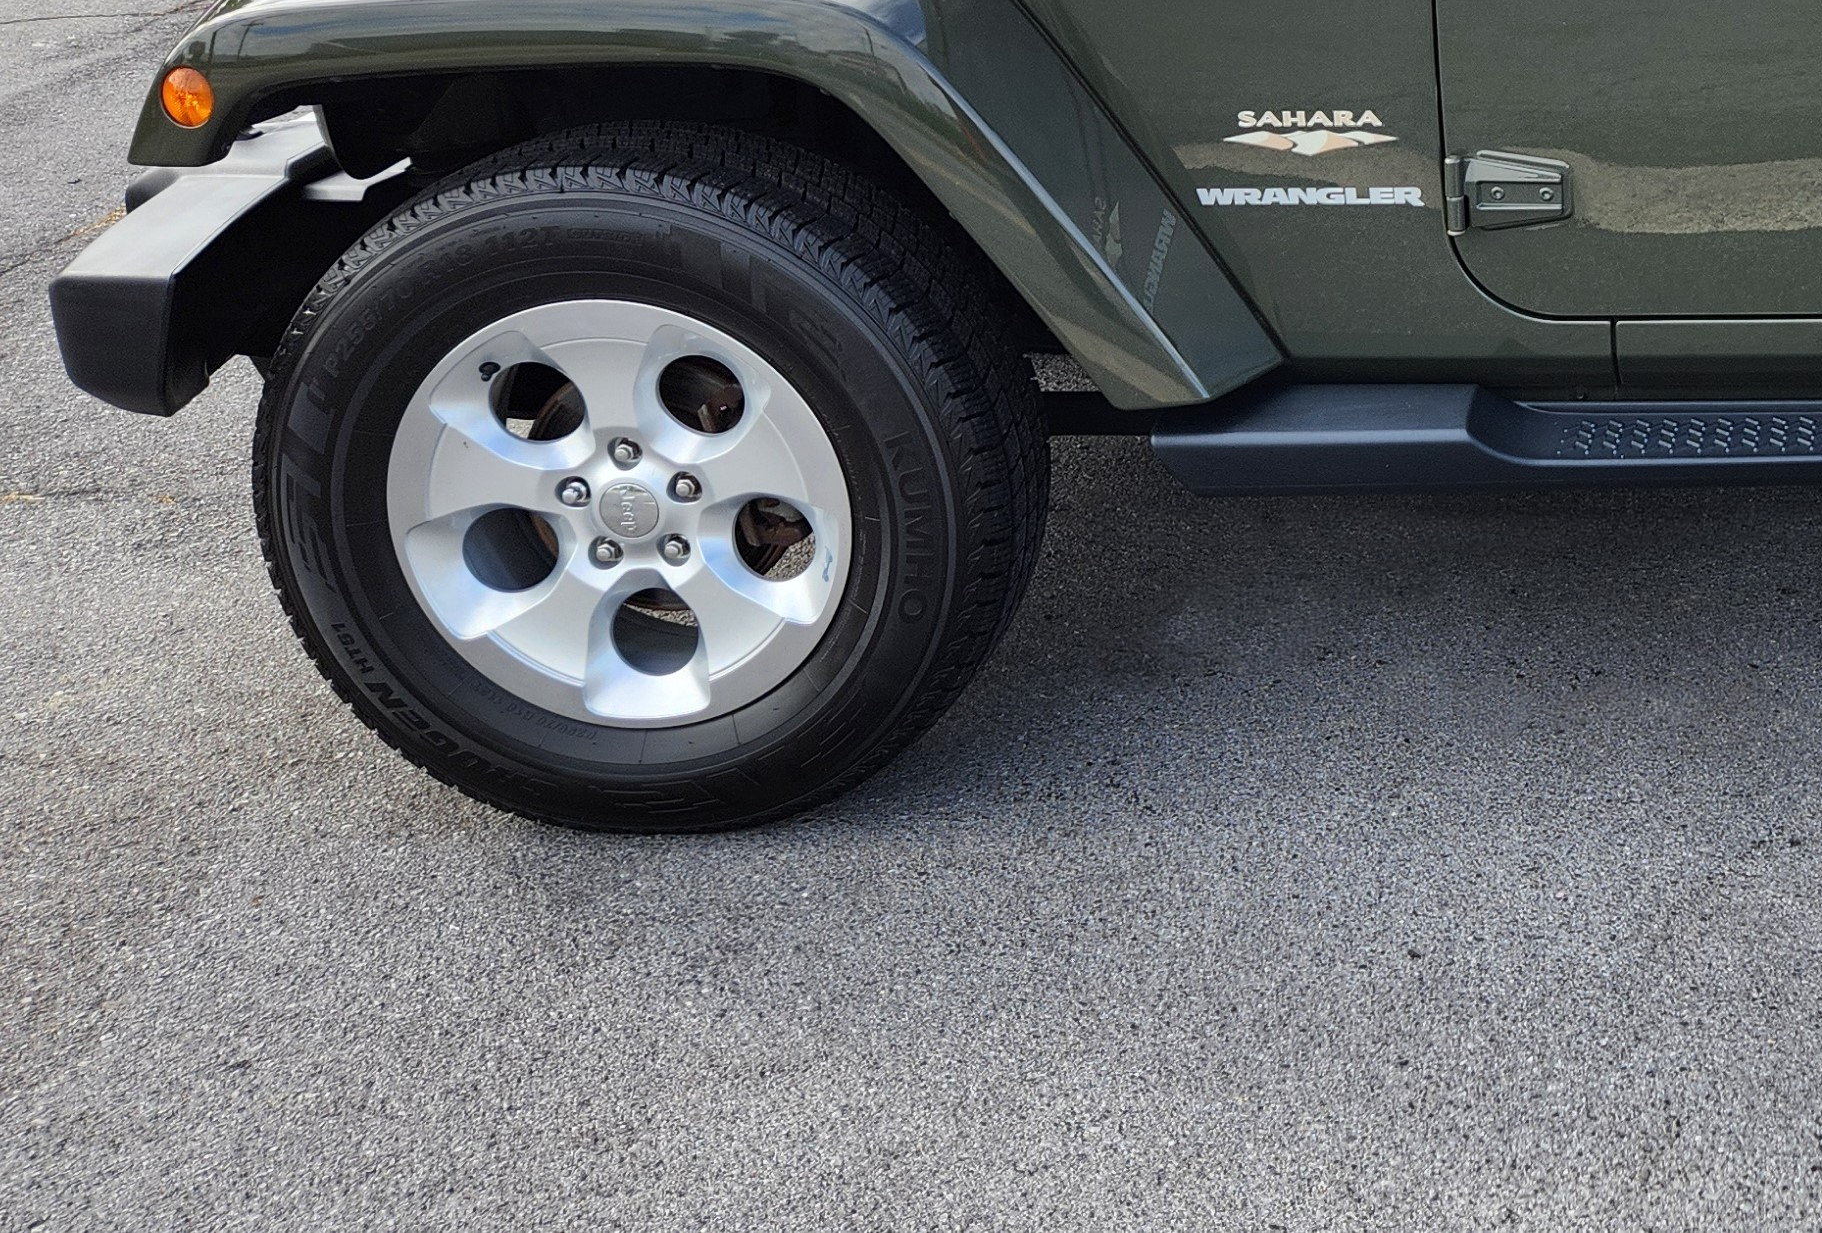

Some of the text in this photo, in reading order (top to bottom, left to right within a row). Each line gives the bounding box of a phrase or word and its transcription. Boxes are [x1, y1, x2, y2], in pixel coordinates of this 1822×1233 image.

[1237, 110, 1384, 128] SAHARA
[1196, 187, 1425, 207] WRANGLER
[883, 430, 936, 622] KUMHO
